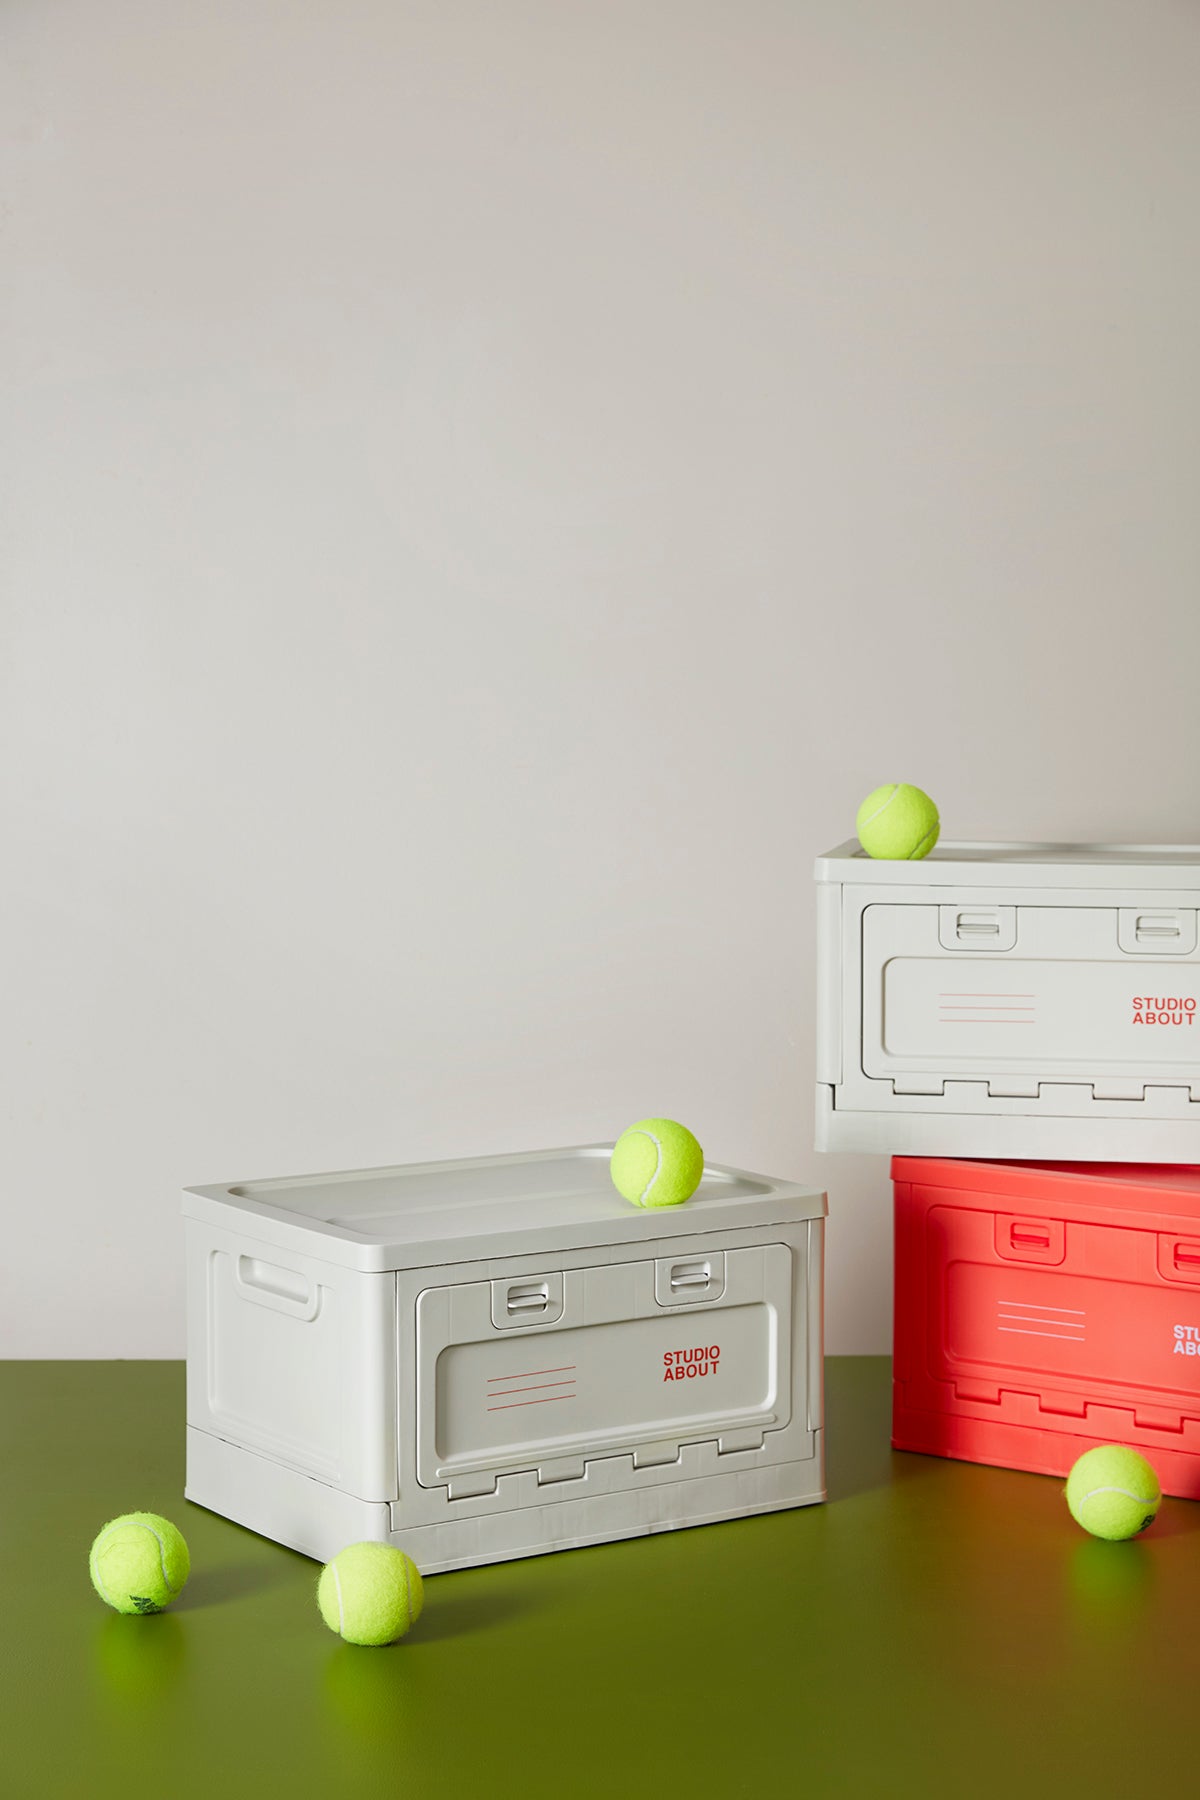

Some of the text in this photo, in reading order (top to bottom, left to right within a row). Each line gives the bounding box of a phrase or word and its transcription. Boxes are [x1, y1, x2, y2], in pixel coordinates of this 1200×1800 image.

[1133, 997, 1196, 1011] STUDIO
[1133, 1012, 1195, 1025] ABOUT
[664, 1345, 720, 1366] STUDIO
[1174, 1340, 1200, 1356] AB
[664, 1361, 719, 1382] ABOUT
